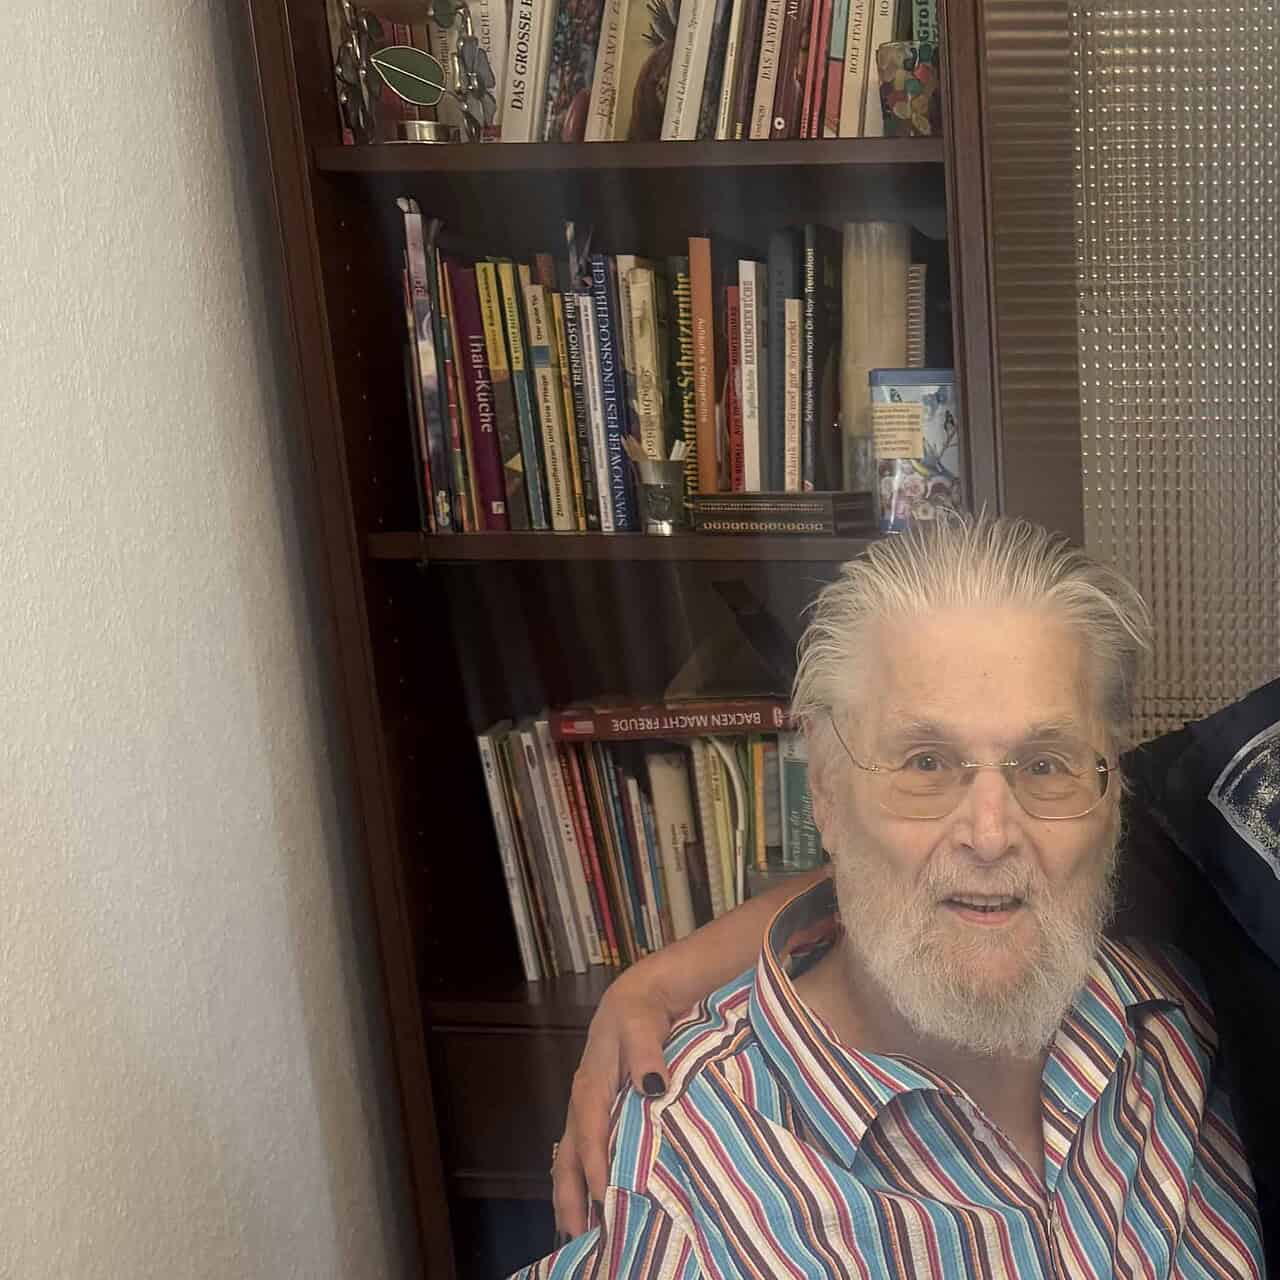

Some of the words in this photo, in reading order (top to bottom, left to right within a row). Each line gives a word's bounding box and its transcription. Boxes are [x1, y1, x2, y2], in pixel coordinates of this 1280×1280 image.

[514, 10, 532, 75] GROSSE
[761, 57, 773, 80] DAS
[510, 79, 526, 111] DAS
[594, 61, 615, 120] ESSEN
[563, 291, 577, 320] FIBEL
[591, 261, 620, 429] FESTUNGSKOCHBUCH
[671, 271, 695, 389] Schatztruhe
[566, 322, 583, 388] TRENNKOST
[467, 334, 494, 433] Thai-Küche
[539, 373, 552, 404] Pflege
[545, 424, 556, 443] und
[608, 431, 629, 528] SPANDOWER
[611, 716, 660, 732] FREUDE
[661, 713, 709, 730] MACHT
[710, 710, 761, 729] BACKEN
